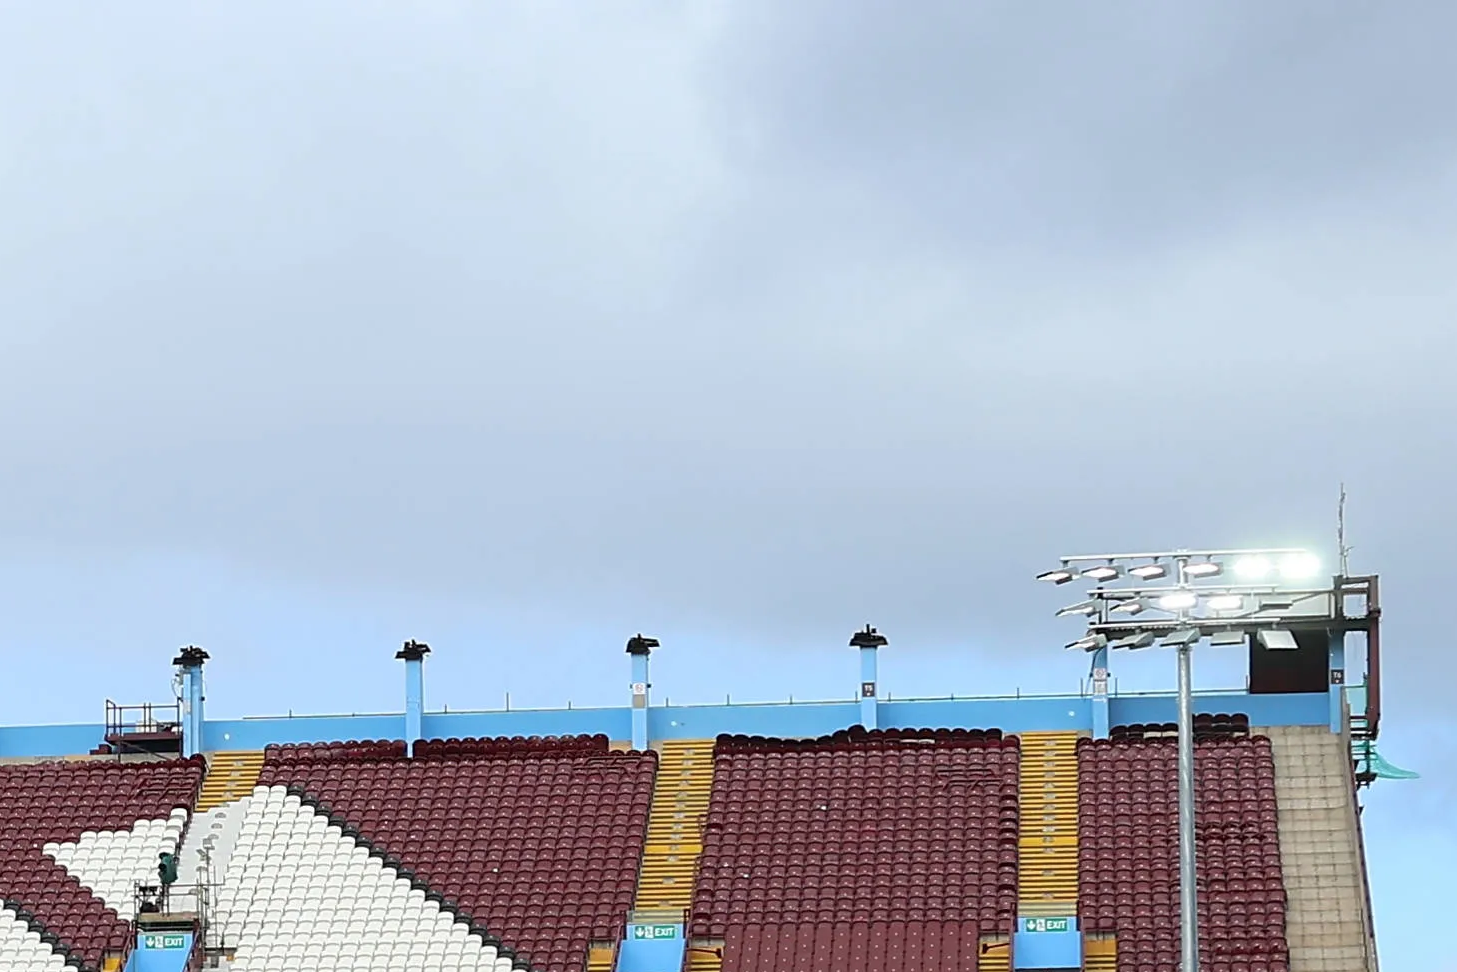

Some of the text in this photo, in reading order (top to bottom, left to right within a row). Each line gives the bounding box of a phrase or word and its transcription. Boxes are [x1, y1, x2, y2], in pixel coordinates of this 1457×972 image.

[1046, 920, 1066, 930] EXIT
[654, 927, 674, 937] EXIT
[164, 938, 184, 947] EXIT
